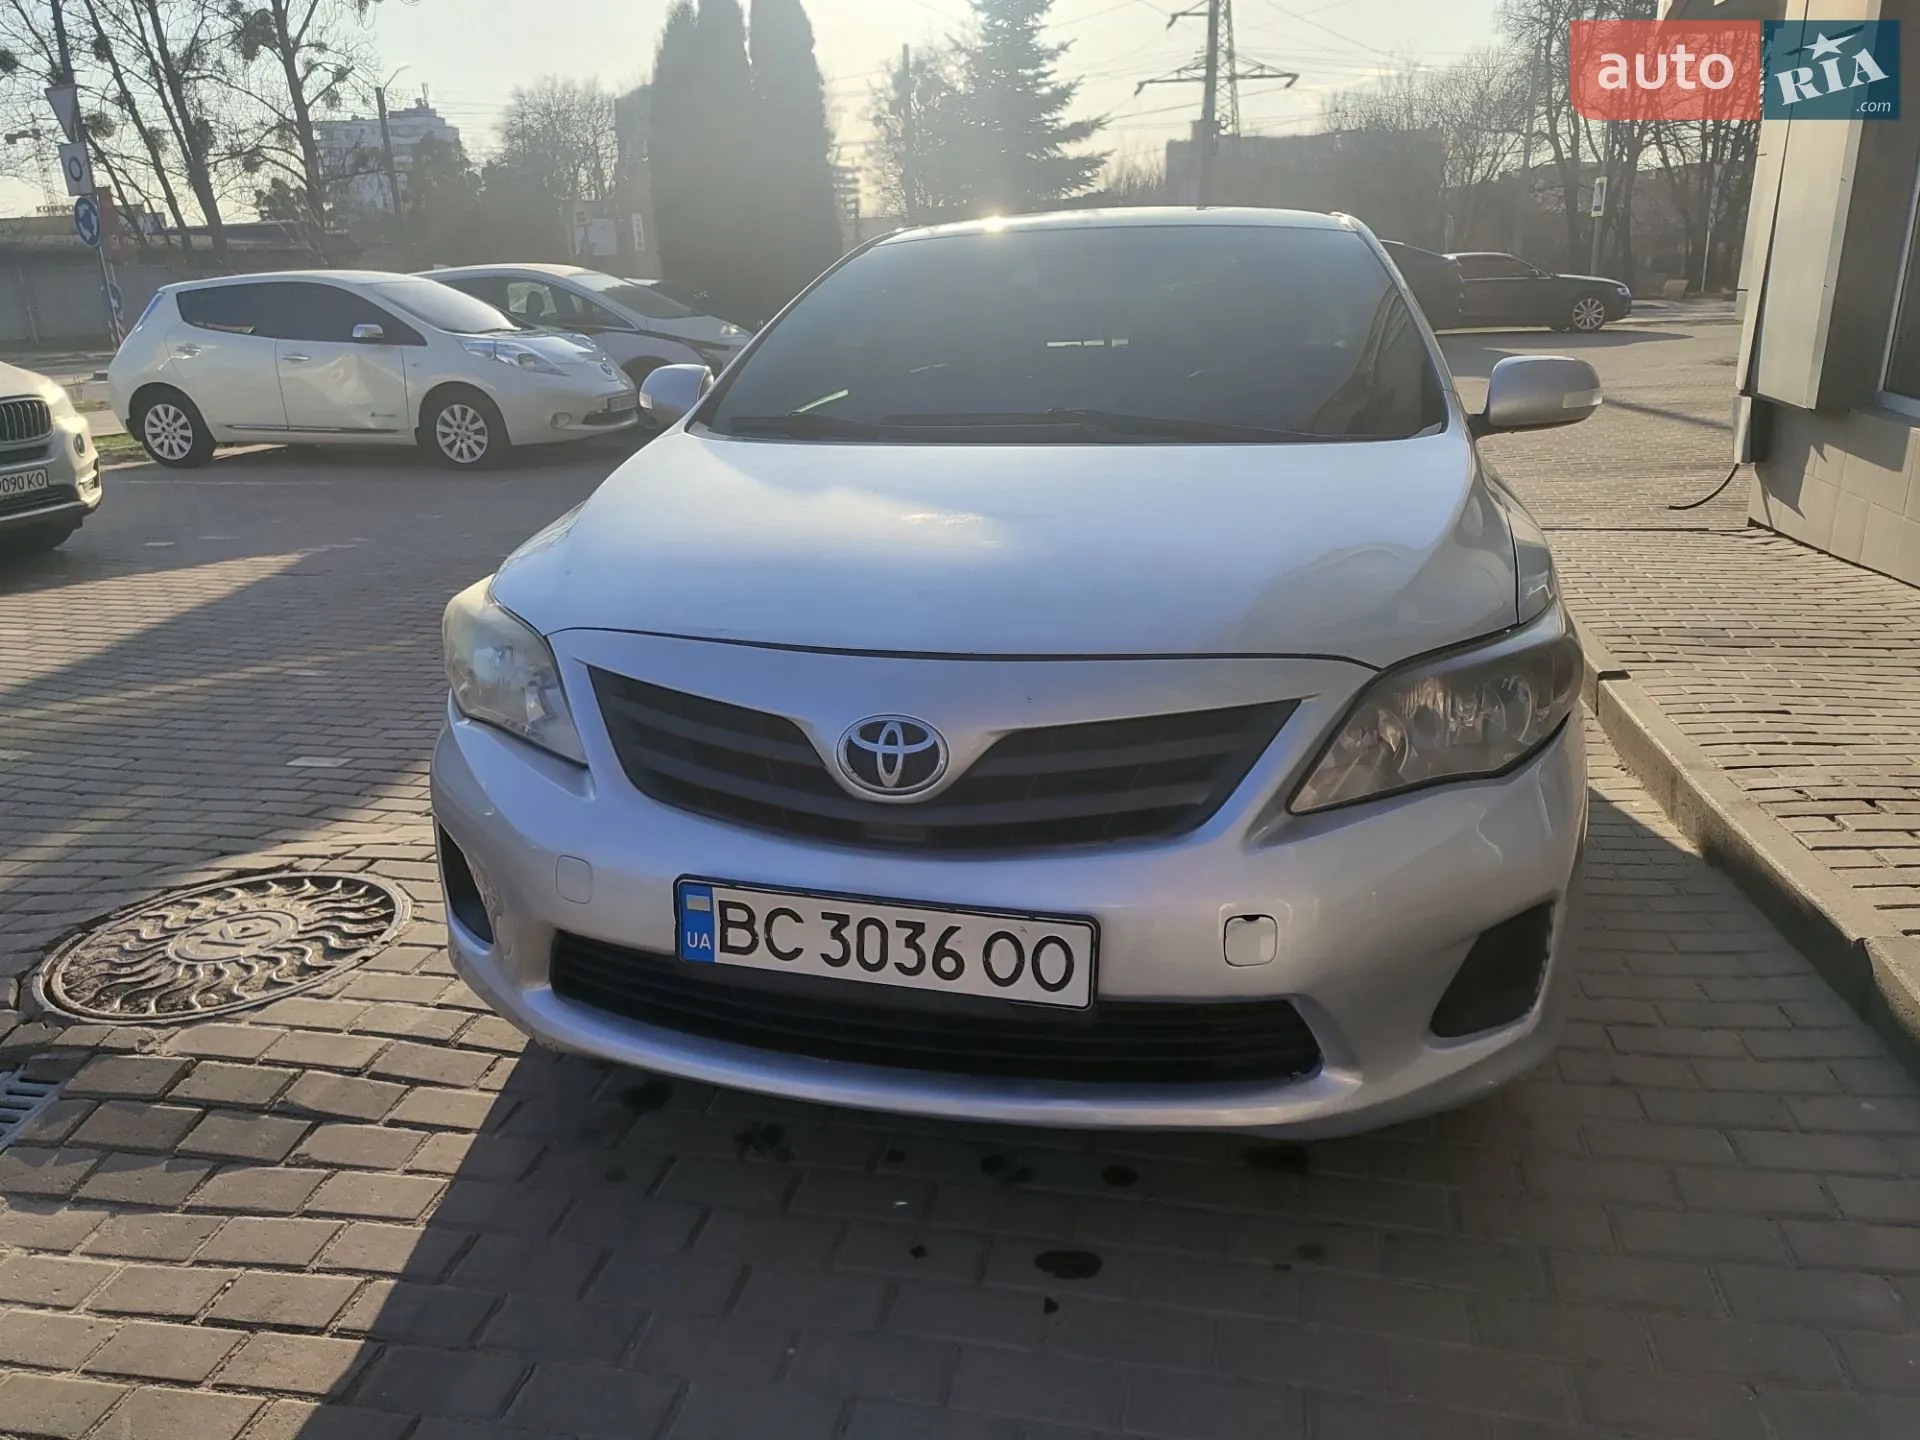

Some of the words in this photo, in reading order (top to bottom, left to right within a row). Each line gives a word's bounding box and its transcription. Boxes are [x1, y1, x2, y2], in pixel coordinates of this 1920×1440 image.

[0, 475, 25, 493] 090
[27, 471, 45, 490] KO
[687, 931, 712, 951] UA
[718, 900, 805, 962] BC
[820, 911, 966, 982] 3036
[982, 930, 1075, 993] OO
